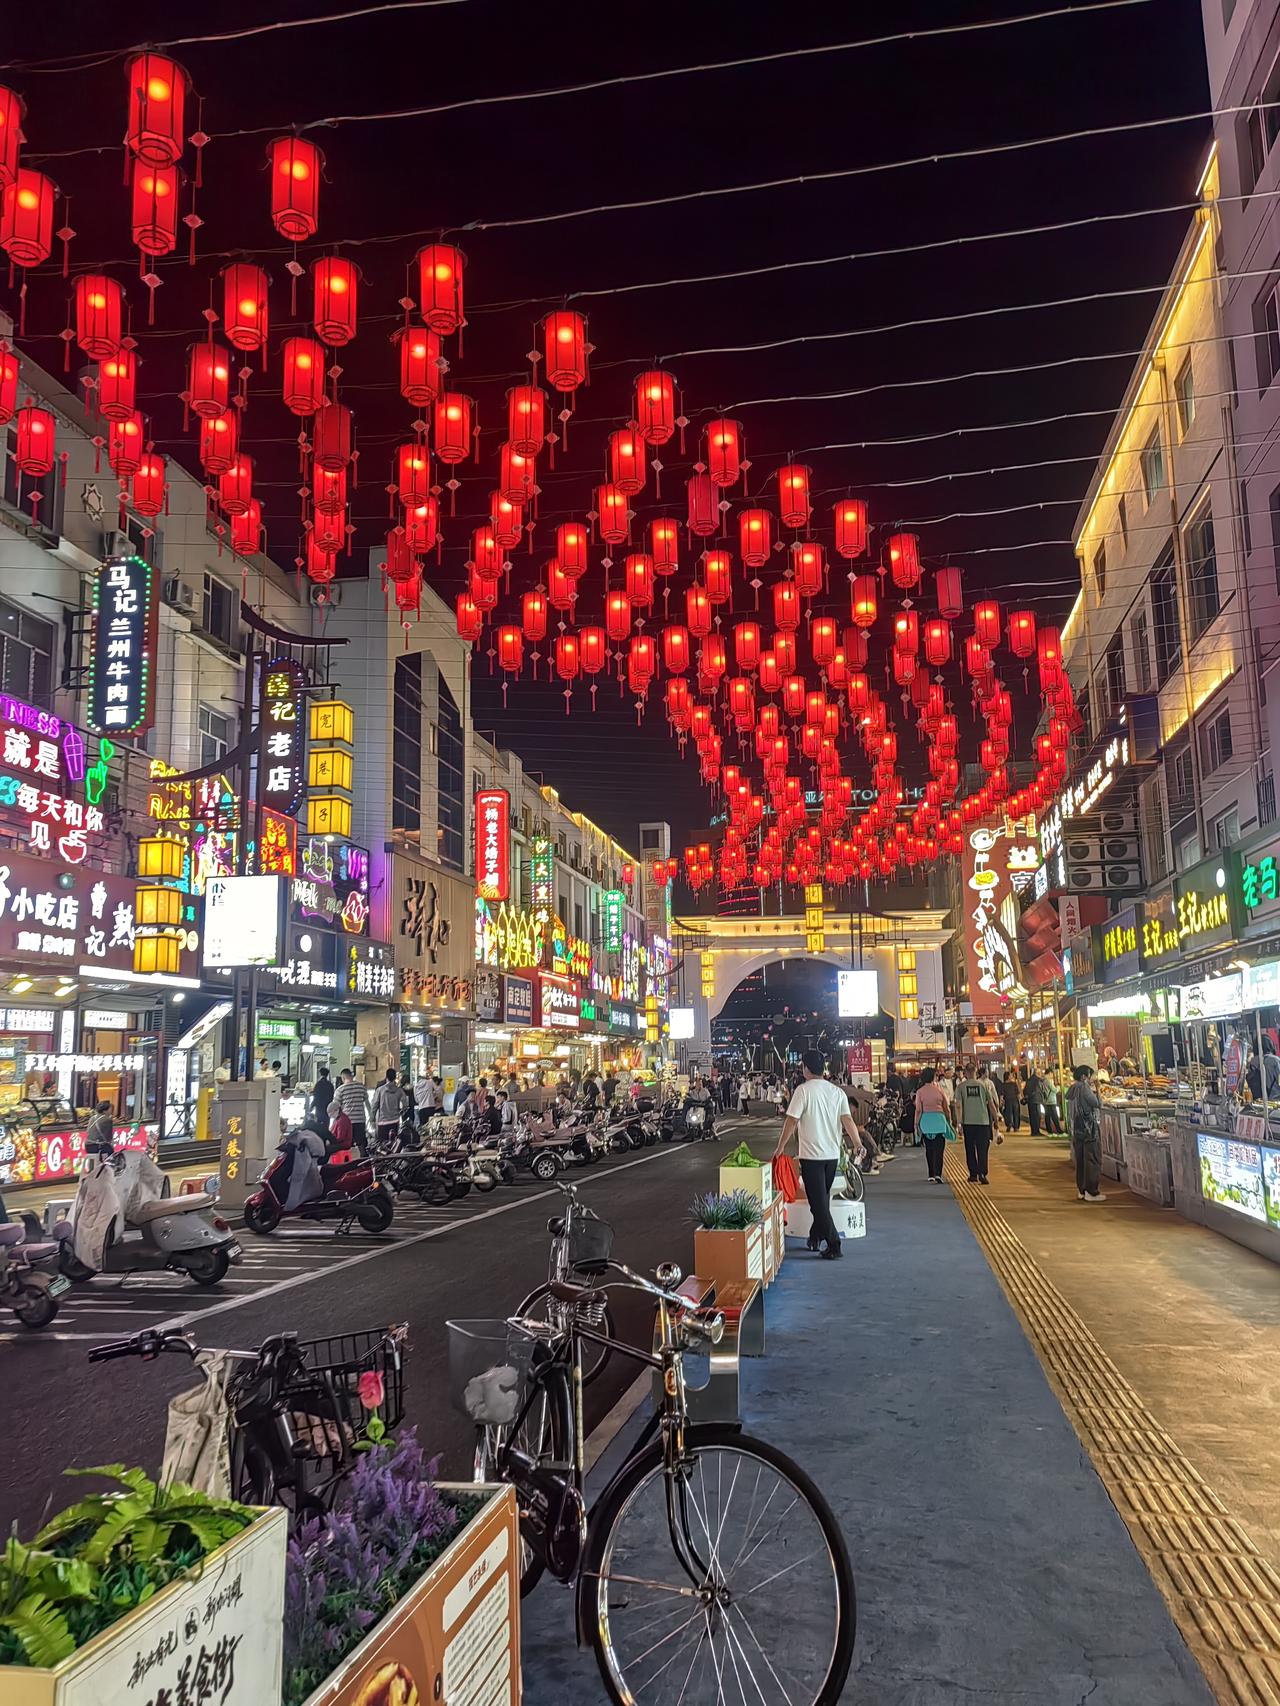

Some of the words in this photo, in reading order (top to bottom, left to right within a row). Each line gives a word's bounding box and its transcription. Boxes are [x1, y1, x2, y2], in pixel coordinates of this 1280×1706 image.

[105, 565, 138, 726] 马记兰州牛肉面
[3, 727, 61, 779] 就是
[17, 783, 104, 832] 每天和你
[1242, 856, 1278, 908] 老马
[10, 887, 79, 931] 小吃店
[226, 1115, 243, 1180] 宽巷子
